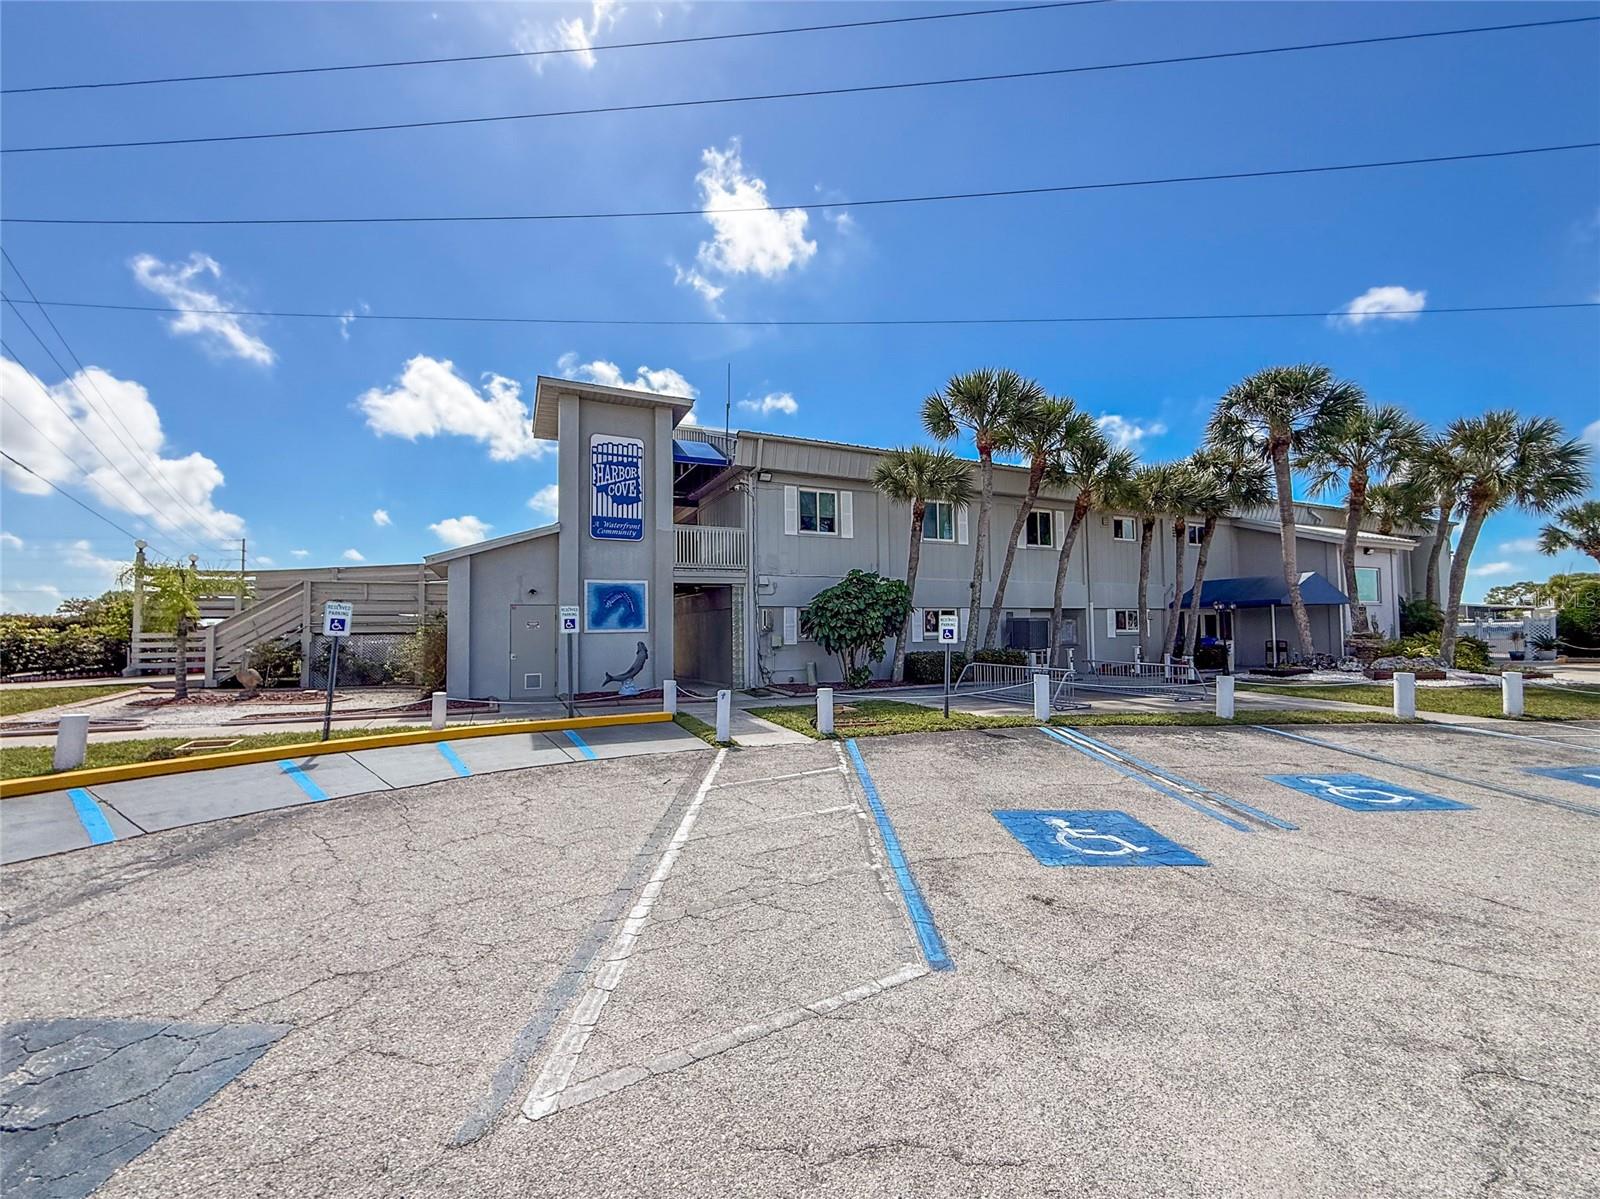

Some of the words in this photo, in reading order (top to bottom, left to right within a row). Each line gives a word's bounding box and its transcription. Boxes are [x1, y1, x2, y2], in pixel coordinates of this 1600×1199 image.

[595, 463, 638, 487] HARBOR
[608, 479, 637, 498] COVE
[596, 528, 637, 538] Community
[602, 520, 641, 531] Waterfront
